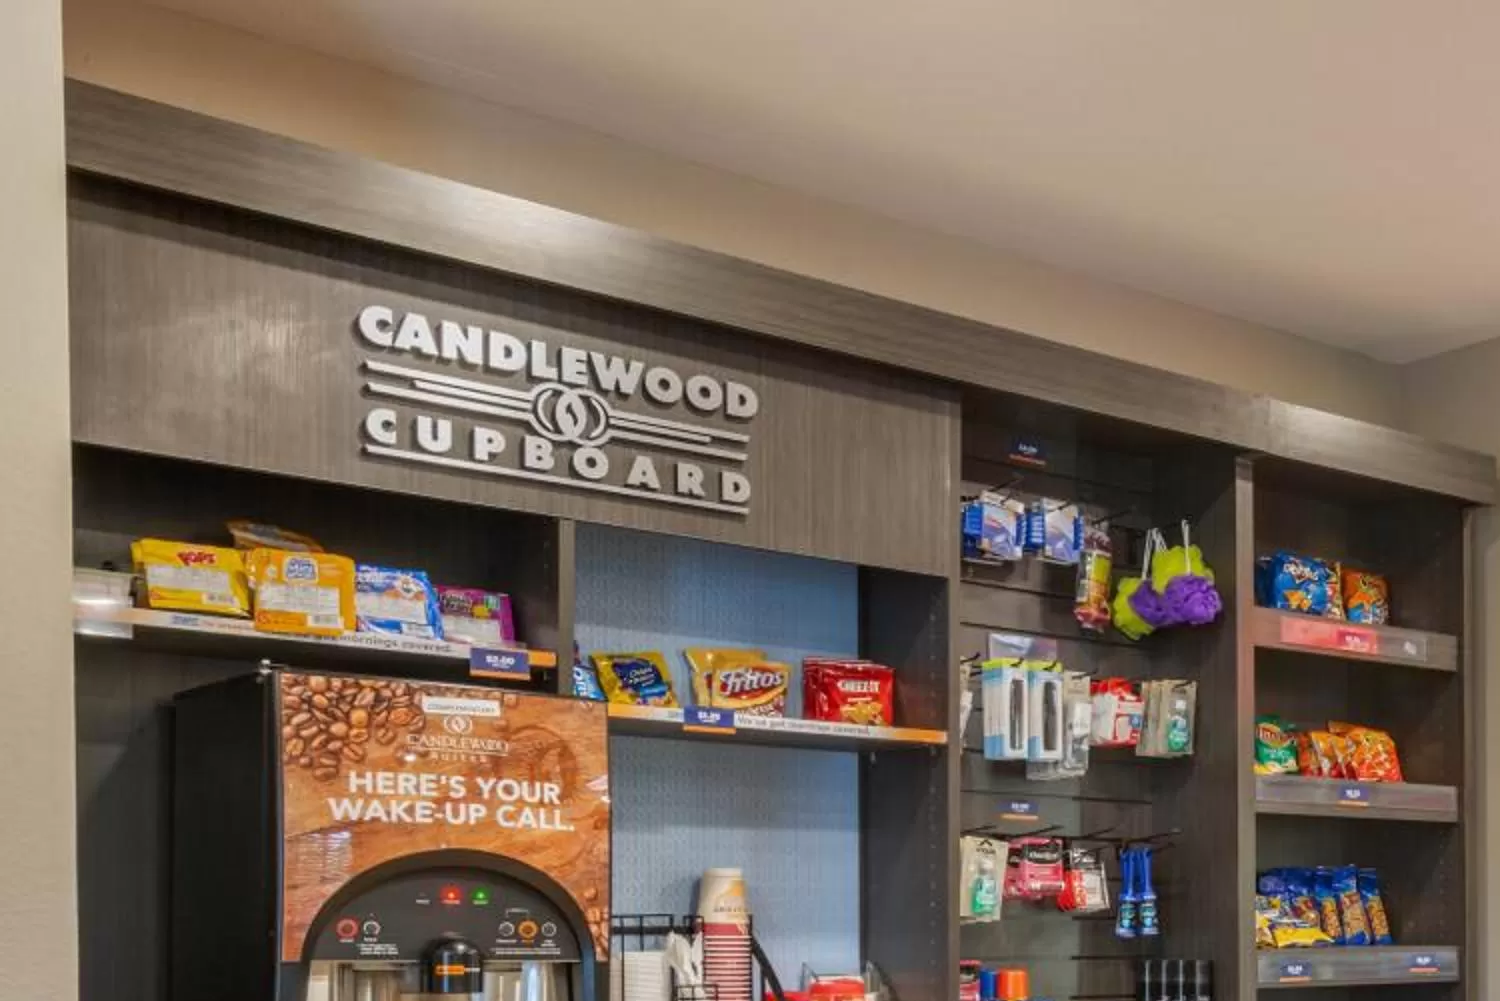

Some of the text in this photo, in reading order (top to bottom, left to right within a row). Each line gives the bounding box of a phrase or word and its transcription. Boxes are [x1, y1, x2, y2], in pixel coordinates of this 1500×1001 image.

[357, 305, 760, 418] CANDLEWOOD
[364, 408, 752, 503] CUPBOARD
[328, 797, 575, 832] WAKE-UP CALL.
[349, 771, 561, 805] HERE'S YOUR
